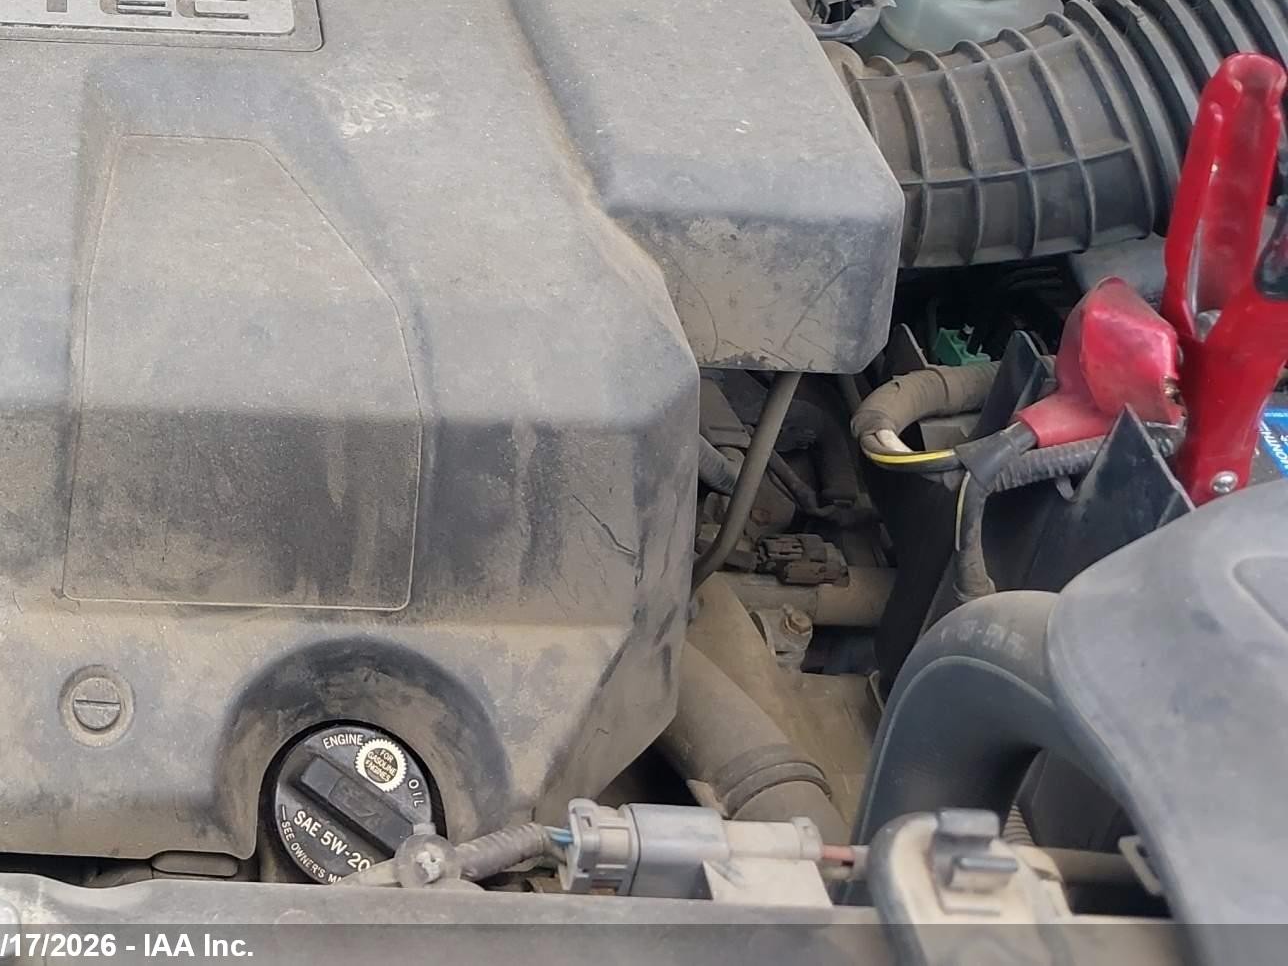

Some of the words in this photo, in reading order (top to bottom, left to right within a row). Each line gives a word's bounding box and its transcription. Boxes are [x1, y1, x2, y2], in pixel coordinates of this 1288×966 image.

[323, 734, 364, 749] ENGINE
[367, 751, 397, 777] GASOLINE
[380, 750, 393, 763] FOR
[408, 779, 425, 808] OIL
[293, 810, 322, 838] SAE
[320, 831, 371, 872] 5W-20
[291, 842, 327, 879] OWNER'S
